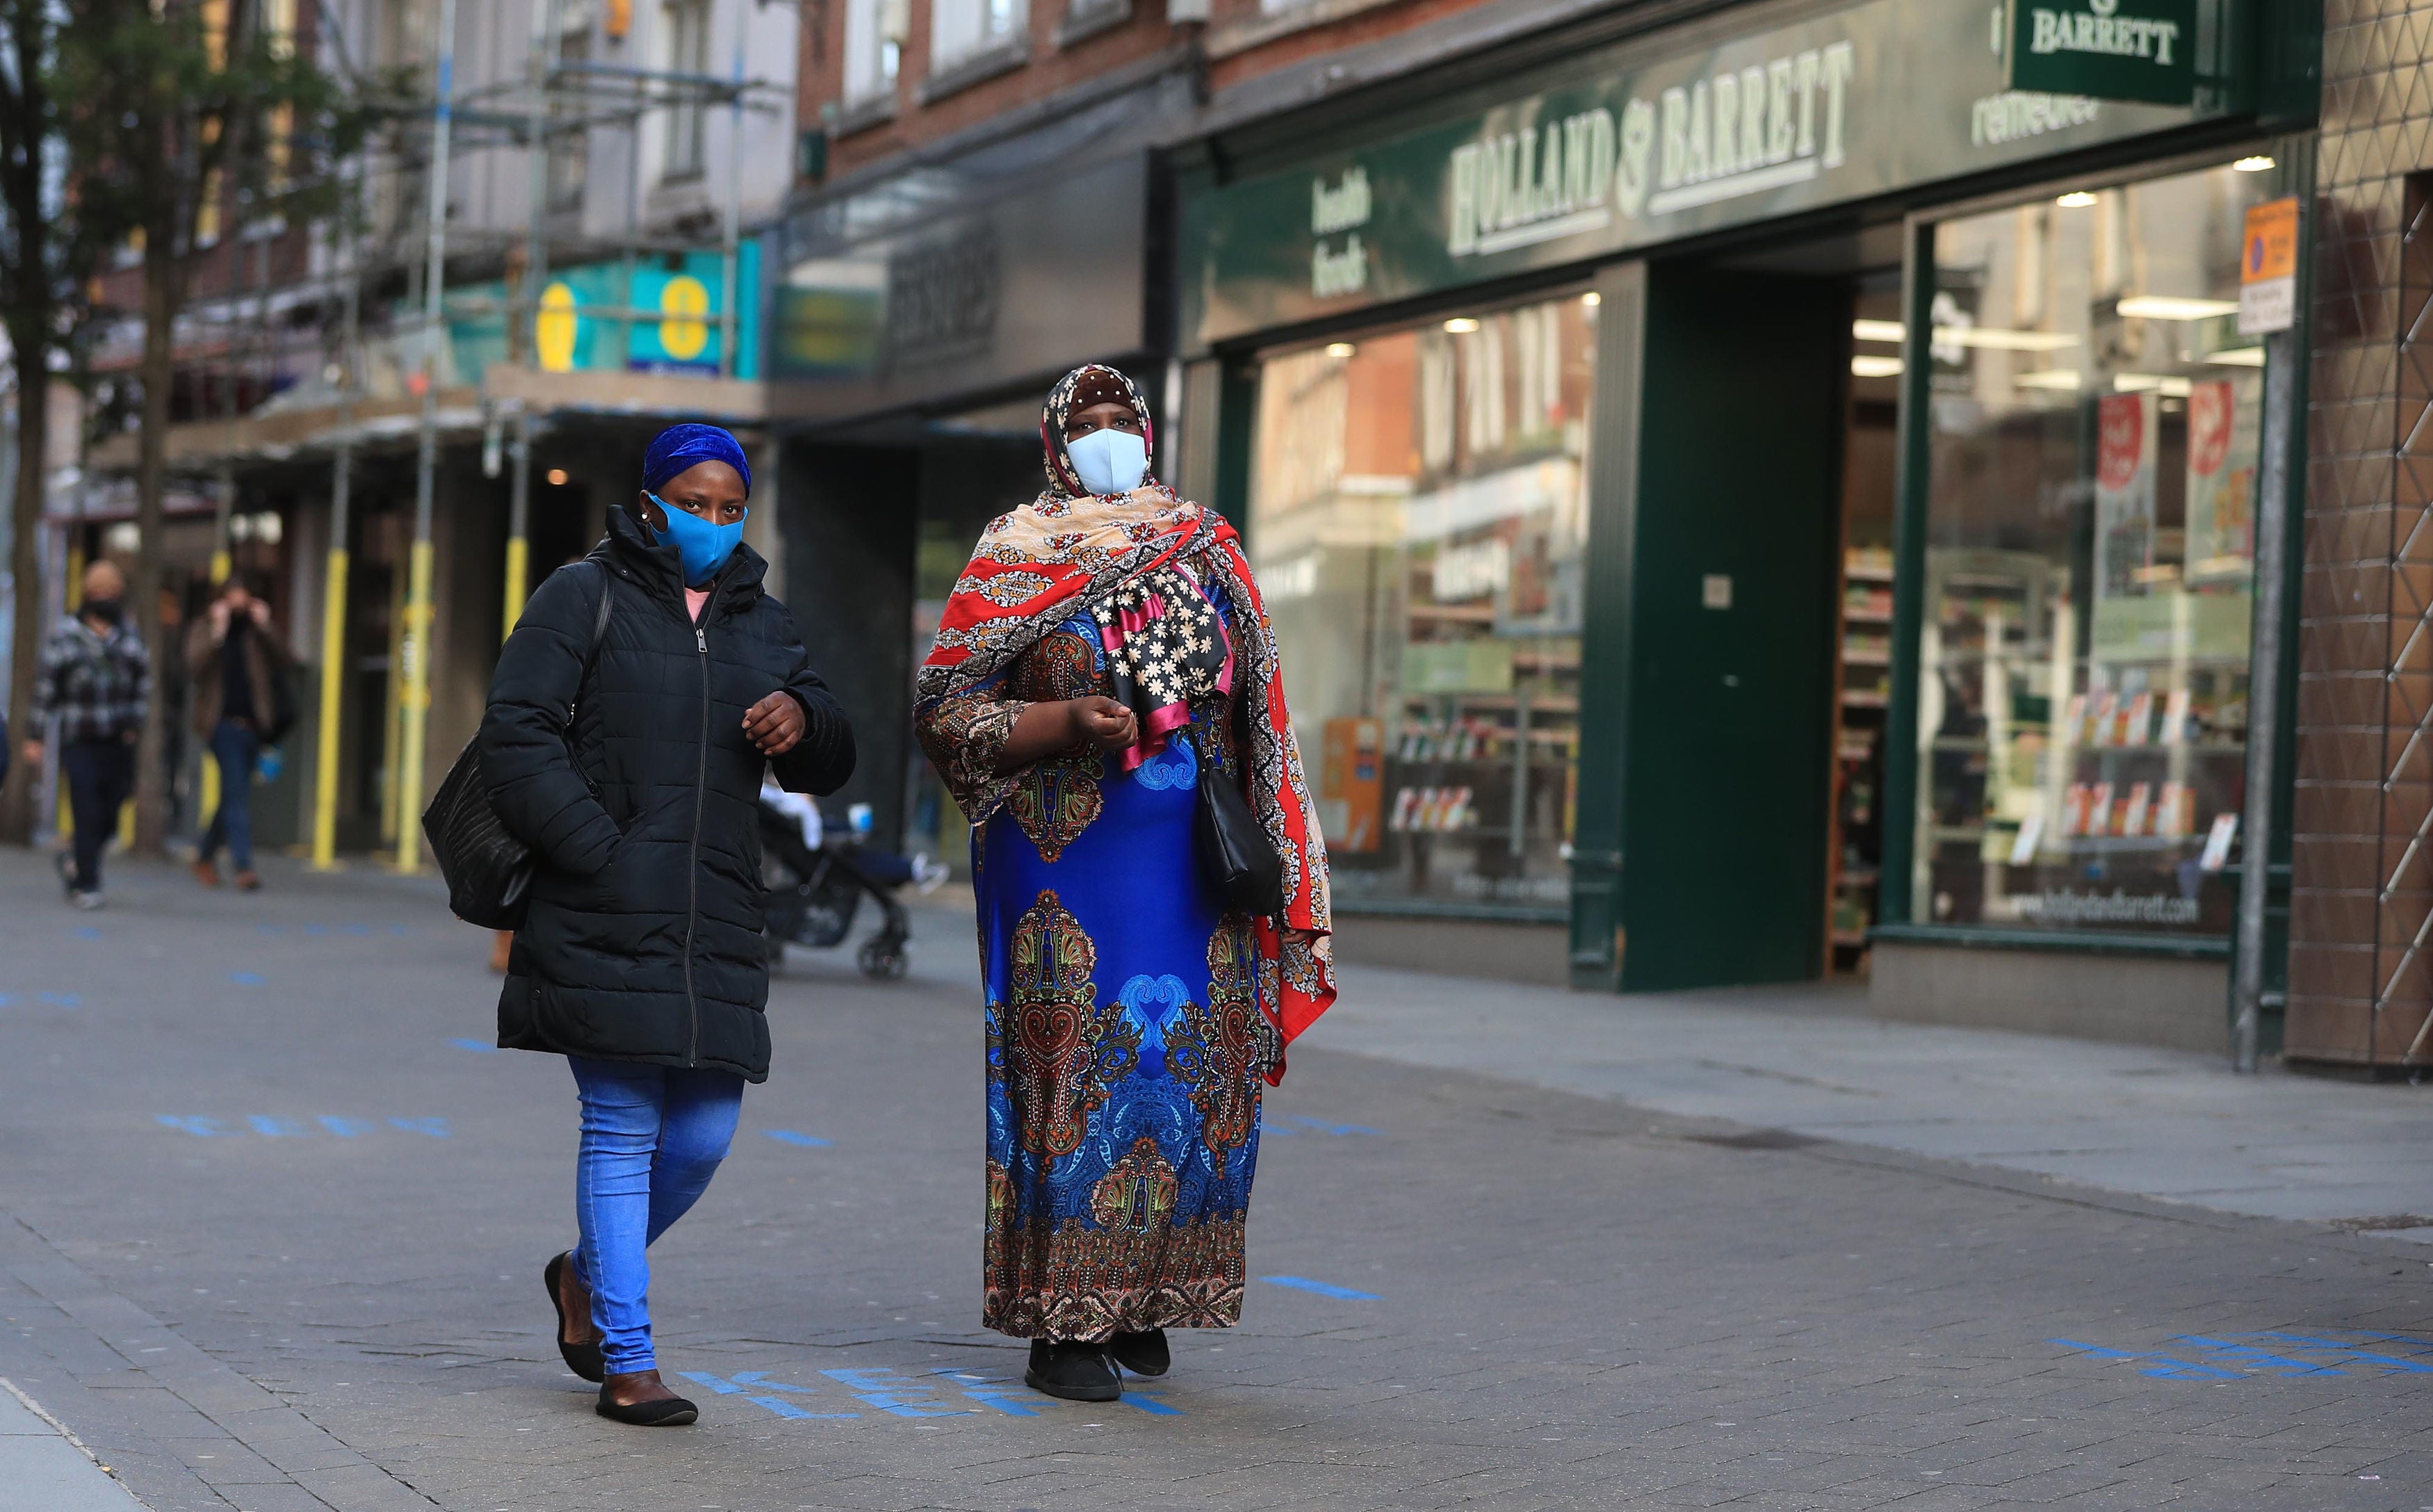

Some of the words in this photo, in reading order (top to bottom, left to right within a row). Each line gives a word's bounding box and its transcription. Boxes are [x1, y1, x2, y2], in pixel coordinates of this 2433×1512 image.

[2030, 7, 2180, 66] BARRETT
[1448, 107, 1617, 257] HOLLAND
[1659, 39, 1854, 190] BARRETT
